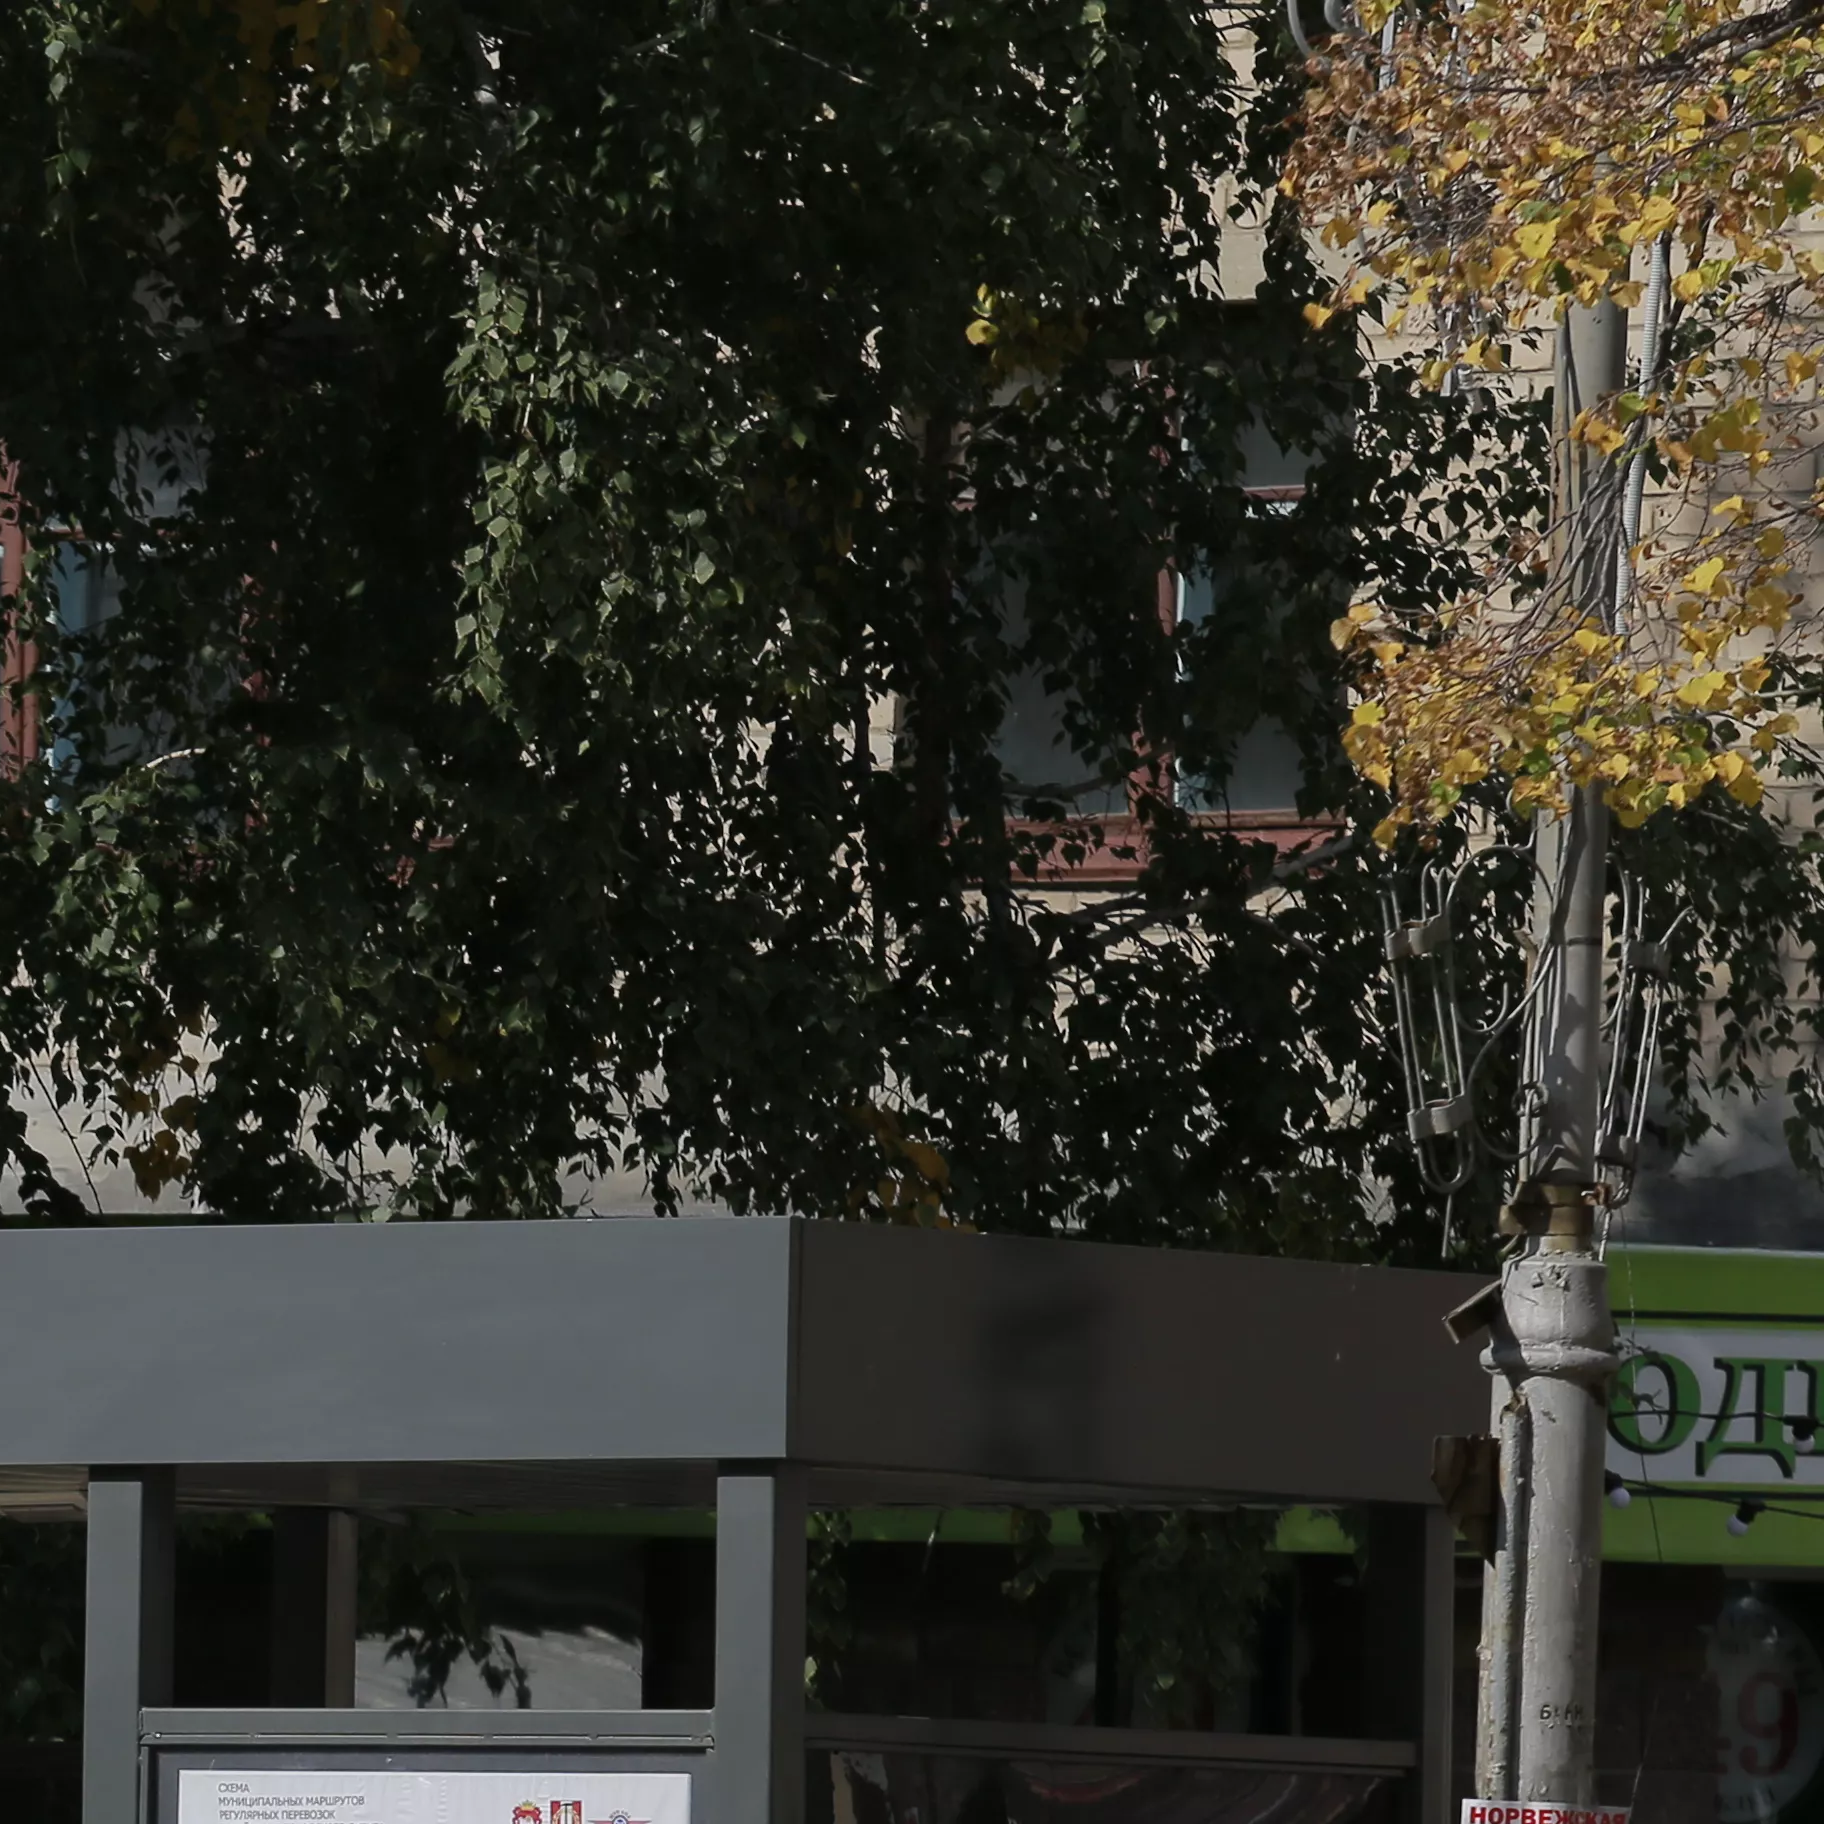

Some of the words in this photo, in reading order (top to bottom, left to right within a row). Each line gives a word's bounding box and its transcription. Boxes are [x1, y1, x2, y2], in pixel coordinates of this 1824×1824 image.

[1608, 1353, 1824, 1479] ОД
[218, 1783, 250, 1792] СХЕМА
[219, 1797, 303, 1807] МУНИЦИПАЛЬНЫХ
[306, 1796, 364, 1806] МАРШРУТОВ
[220, 1810, 279, 1820] РЕГУЛЯРНЫХ
[282, 1810, 336, 1819] ПЕРЕВОЗОК
